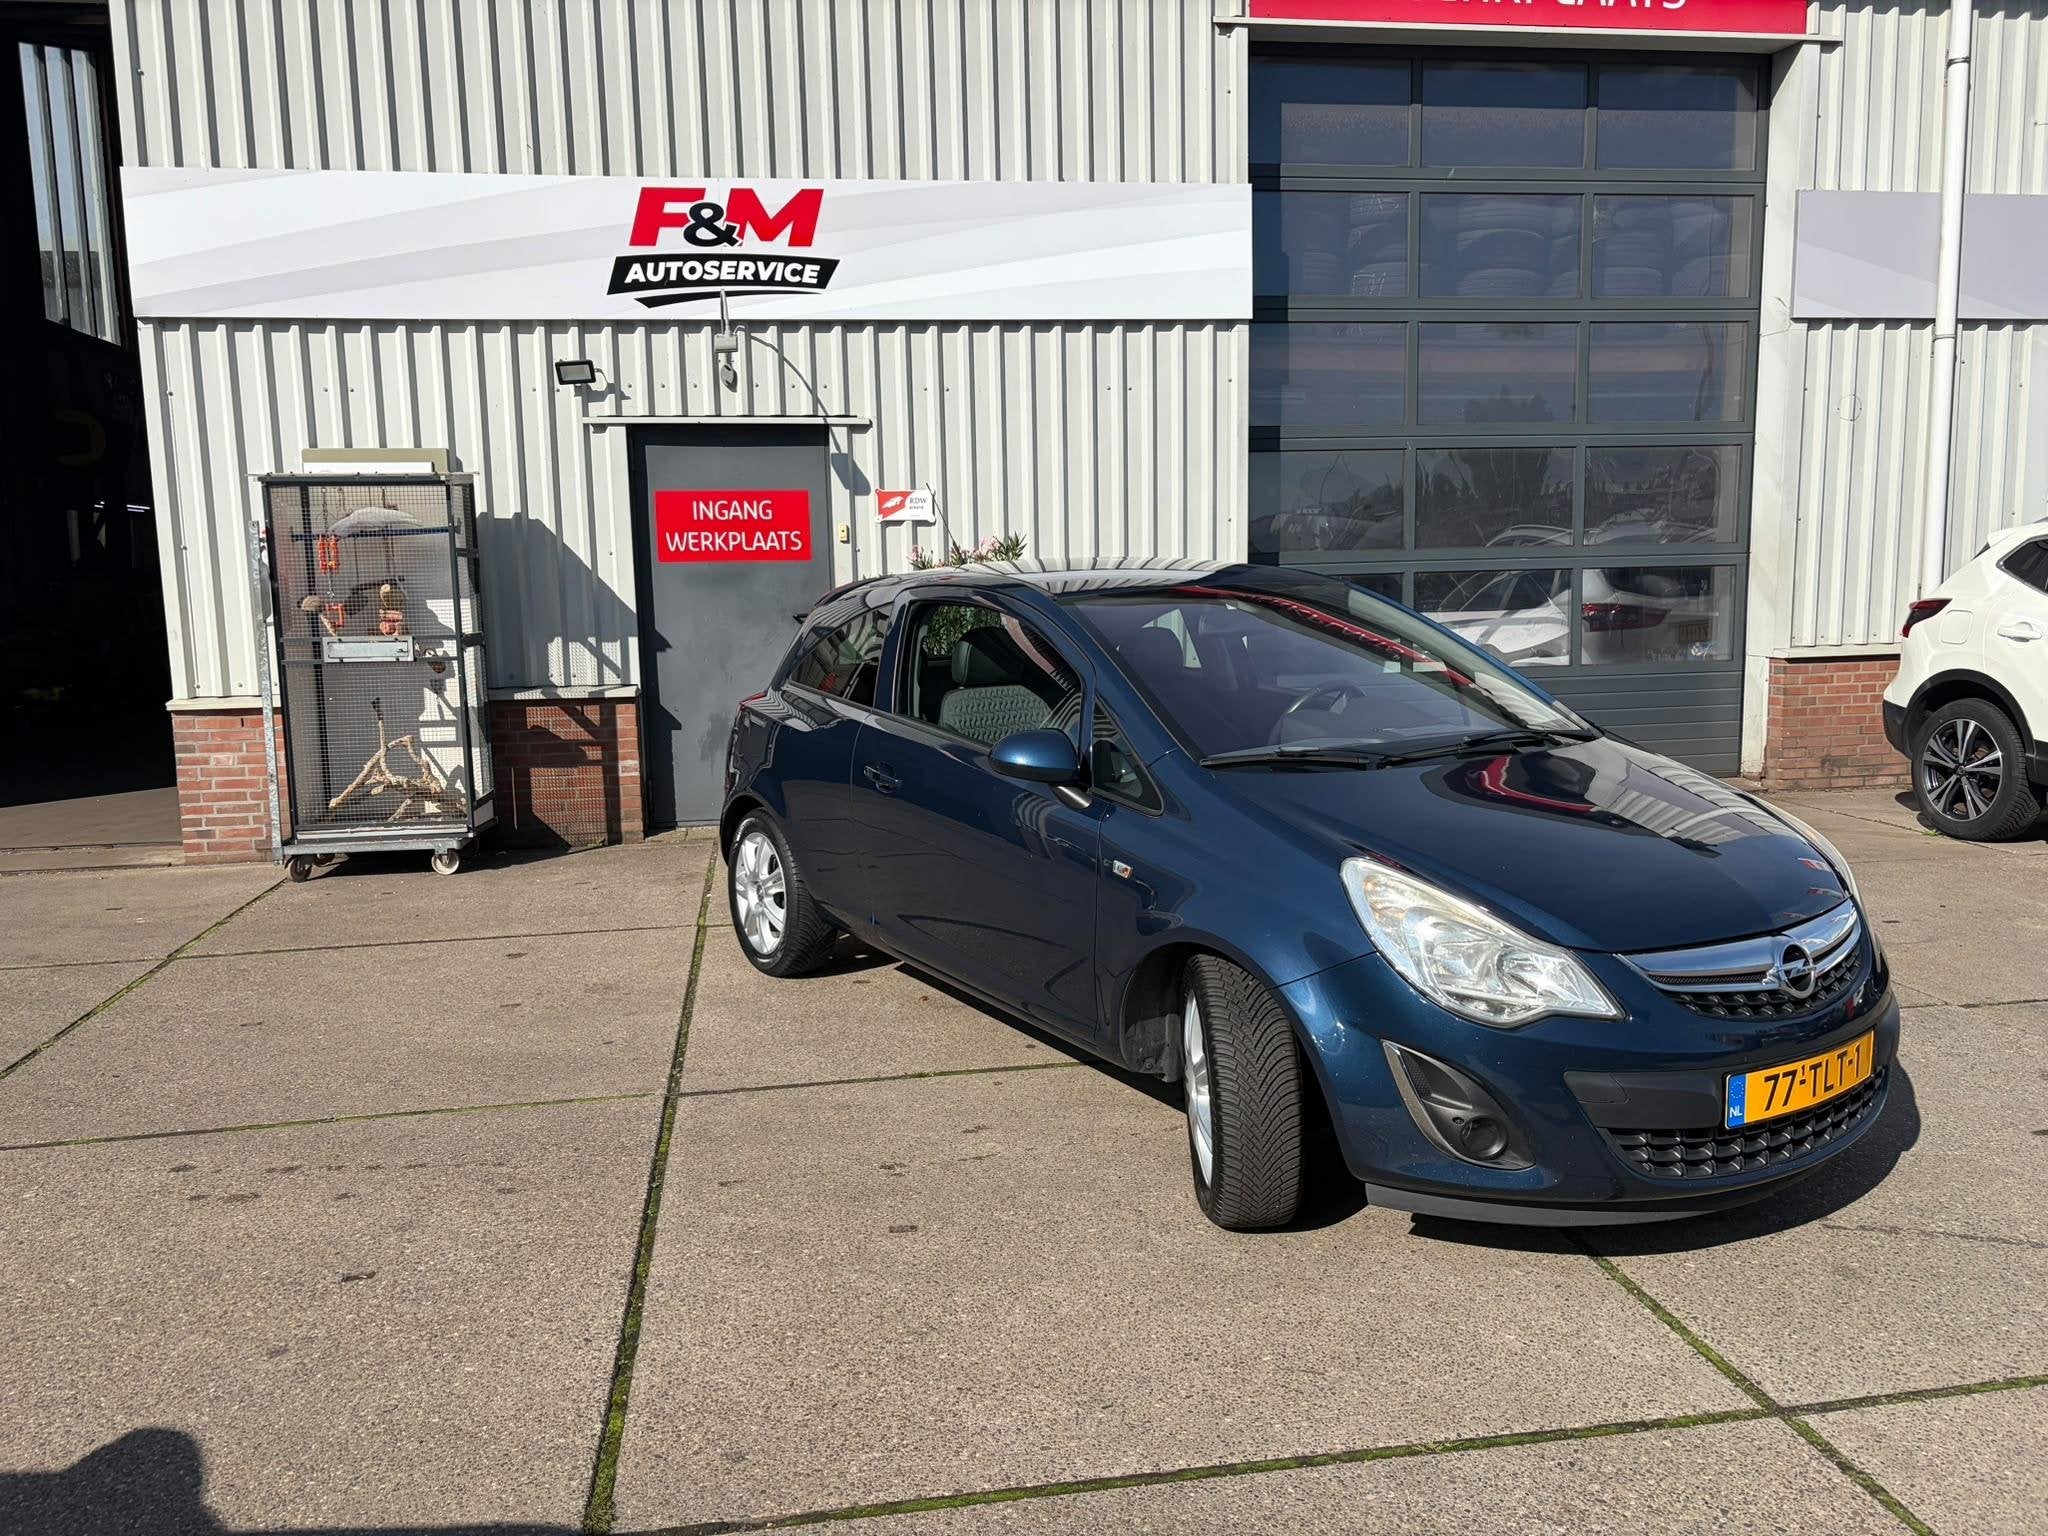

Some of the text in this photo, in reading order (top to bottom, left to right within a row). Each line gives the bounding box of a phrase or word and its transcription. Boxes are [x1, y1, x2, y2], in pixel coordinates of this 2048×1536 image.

[629, 187, 824, 247] F&M
[624, 260, 821, 284] AUTOSERVICE
[692, 499, 773, 521] INGANG
[665, 530, 802, 552] WERKPLAATS
[1729, 1106, 1743, 1118] NL
